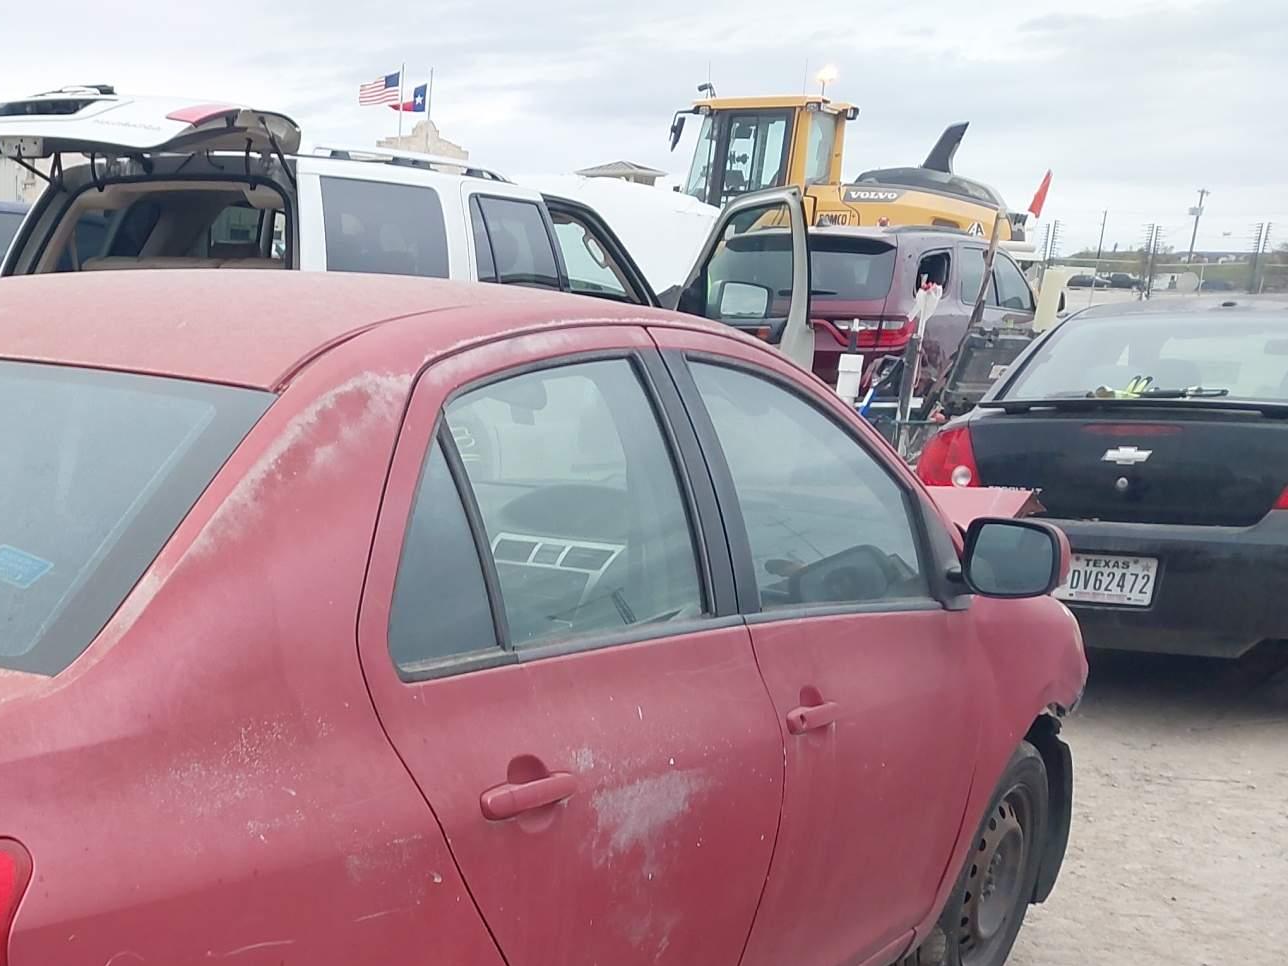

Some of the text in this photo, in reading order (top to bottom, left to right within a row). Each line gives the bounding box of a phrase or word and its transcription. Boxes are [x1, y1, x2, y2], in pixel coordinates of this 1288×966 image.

[849, 190, 898, 200] VOLVO
[1083, 558, 1131, 570] TEXAS
[1069, 569, 1151, 595] DV62472
